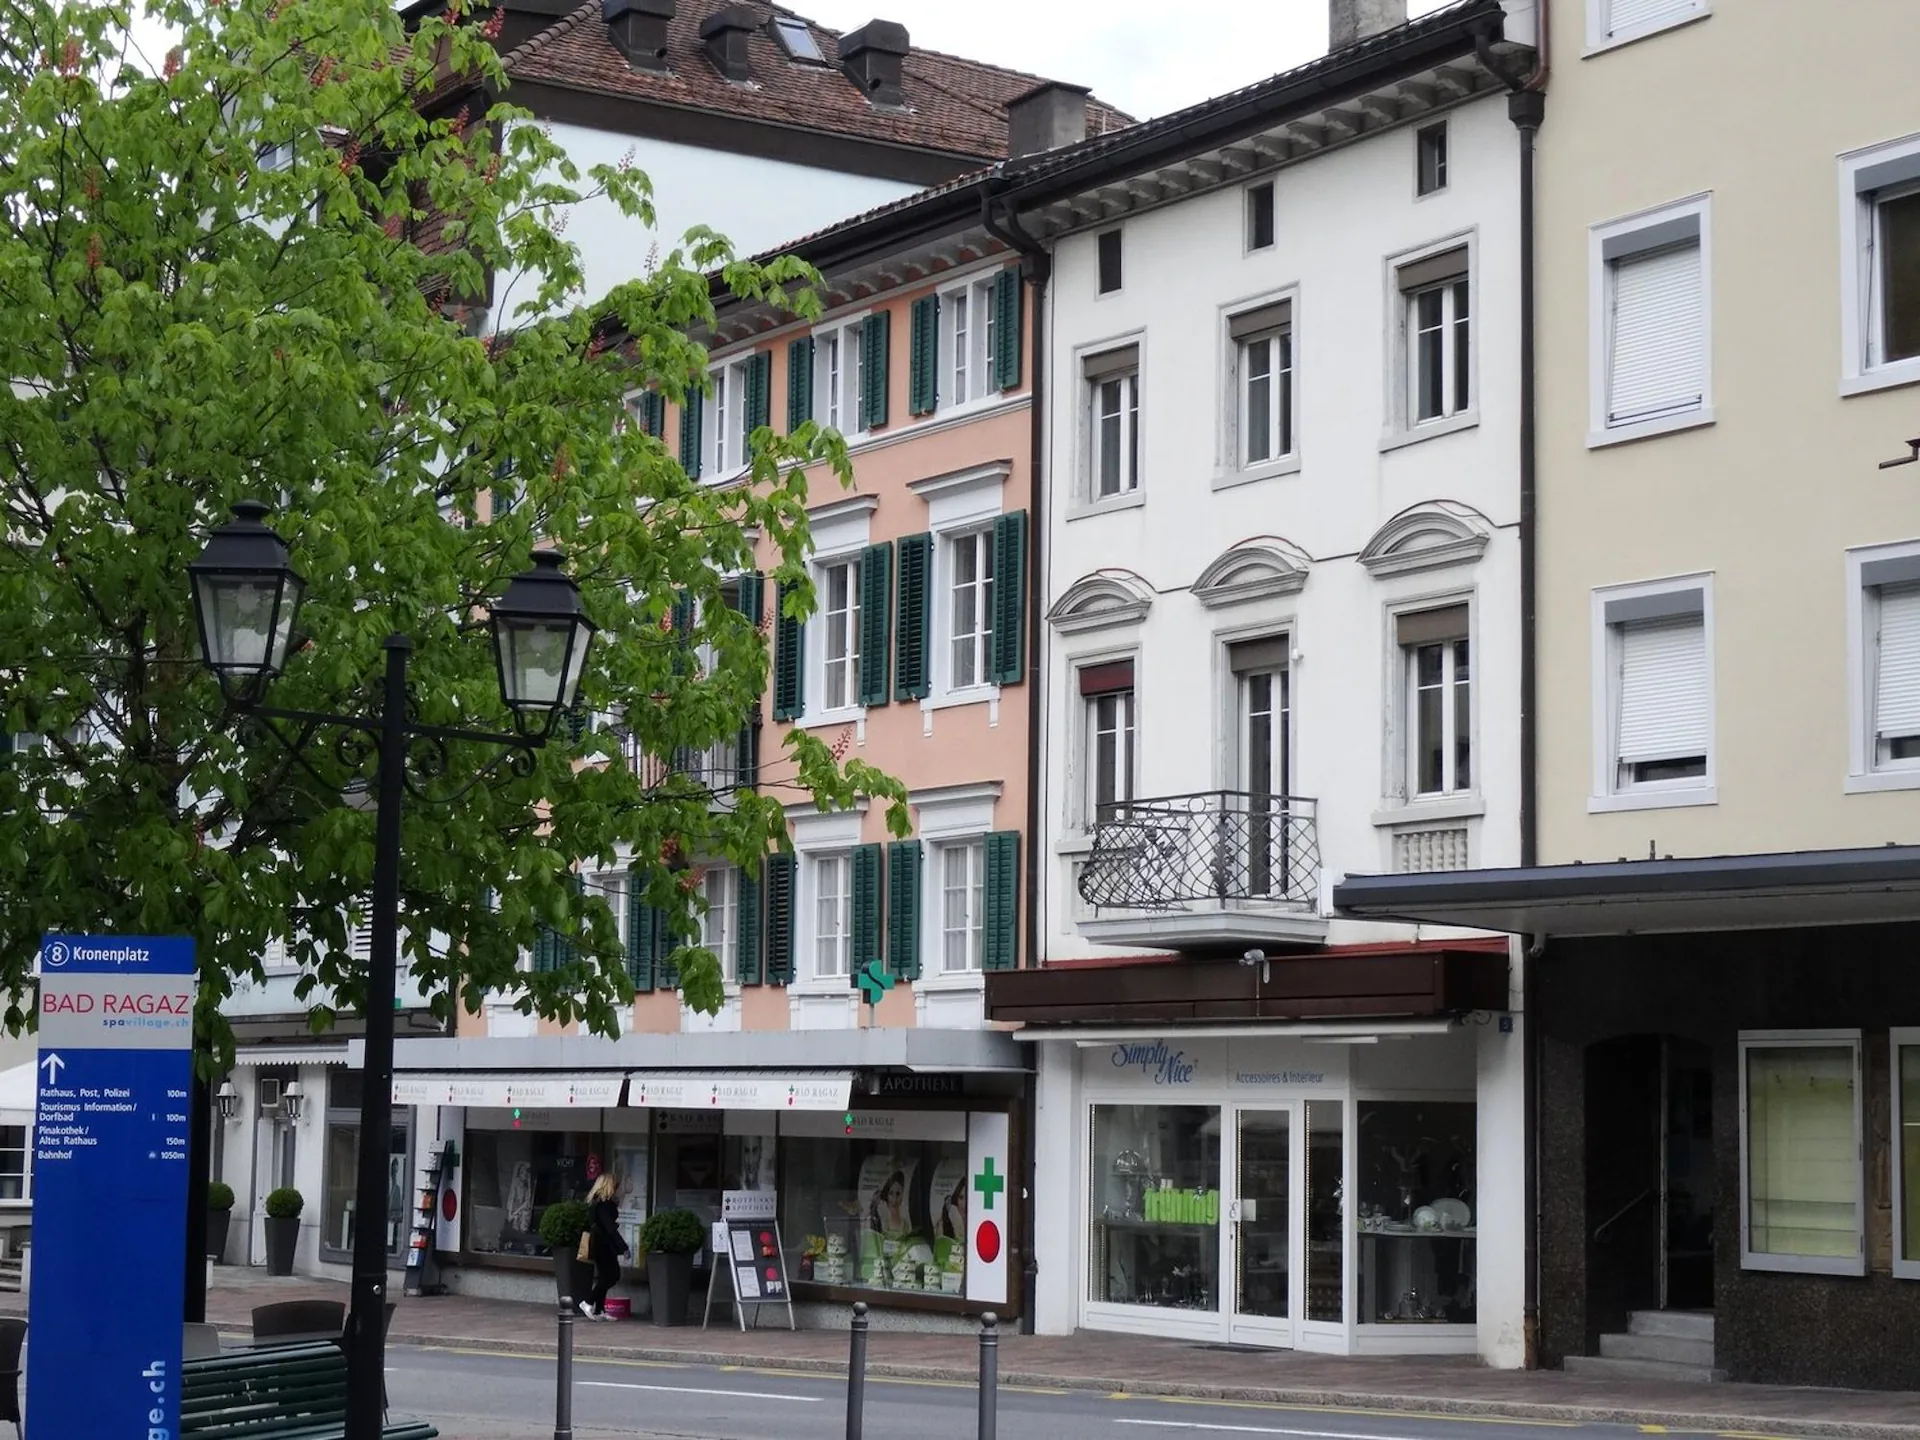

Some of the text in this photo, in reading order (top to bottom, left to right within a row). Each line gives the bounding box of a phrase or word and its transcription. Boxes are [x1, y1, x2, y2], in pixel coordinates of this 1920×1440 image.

[51, 946, 149, 964] 8 Kronenplatz
[43, 994, 189, 1014] BAD RAGAZ
[103, 1017, 189, 1028] spavillage.ch
[1111, 1038, 1193, 1084] Simply Nice
[1236, 1071, 1281, 1083] Accessoires
[1282, 1071, 1288, 1083] &
[40, 1088, 187, 1099] Rathaus, Post, Polizei 100m
[41, 1102, 81, 1111] Tourismus
[39, 1113, 186, 1122] Dorfbad 100m
[39, 1136, 186, 1146] Altes Rathaus 150m
[38, 1151, 186, 1160] Bahnhof 1050m
